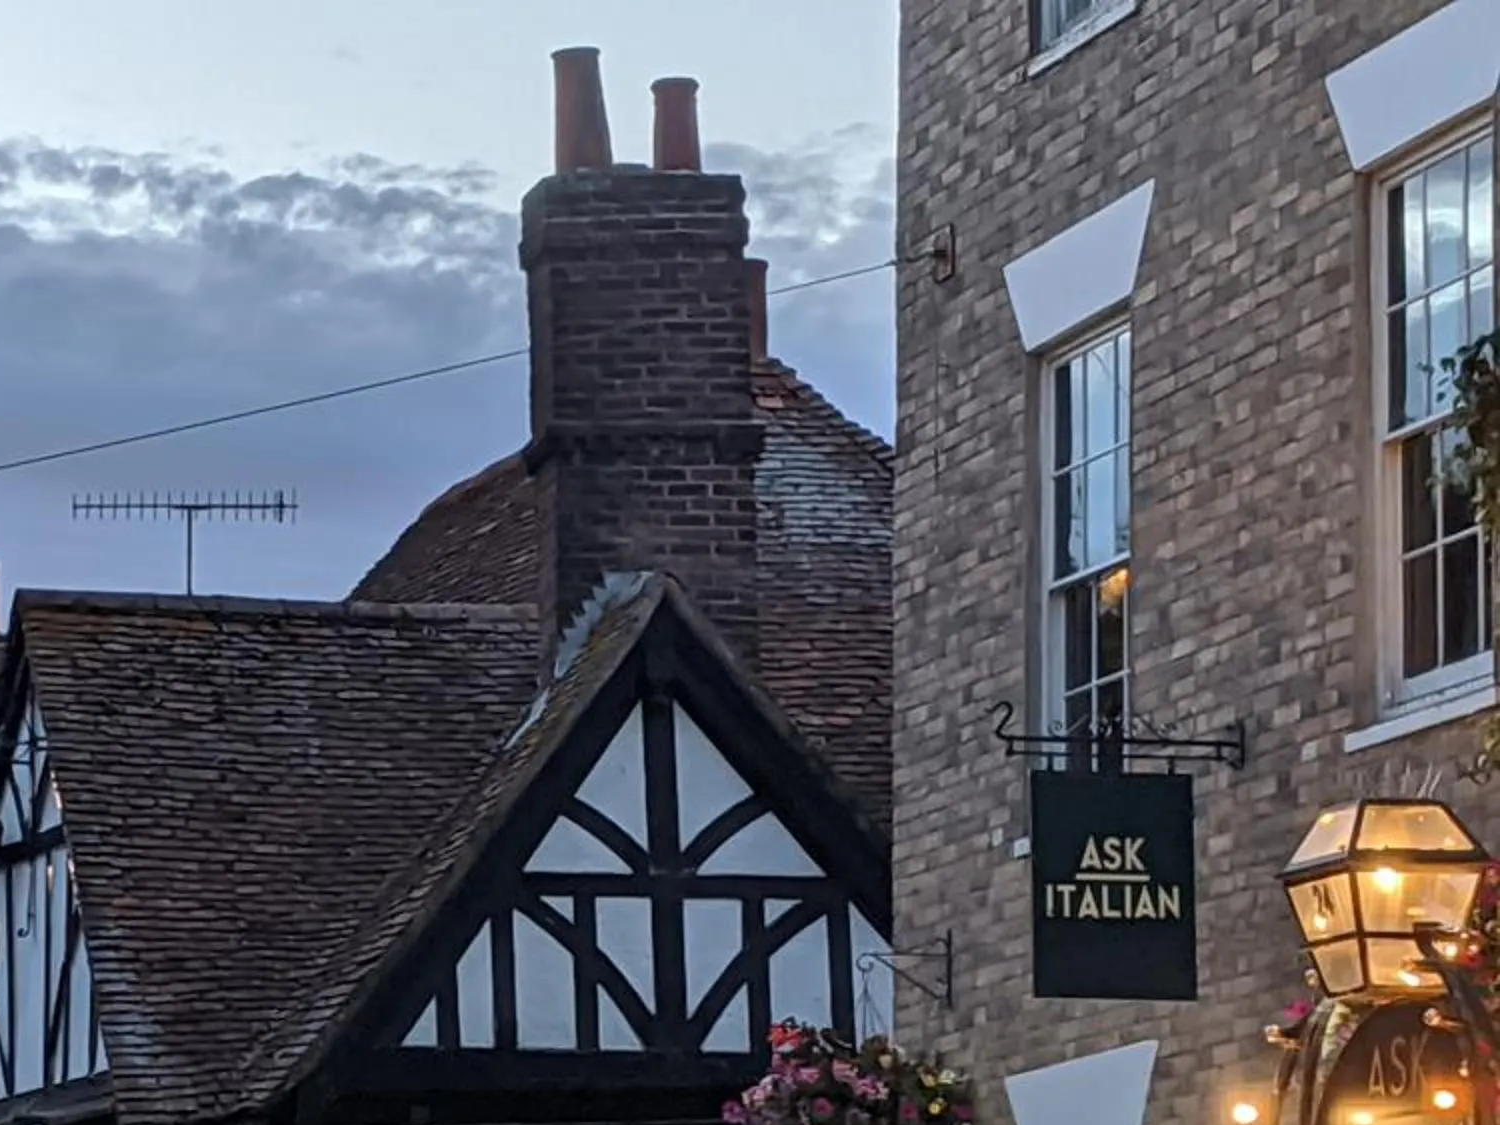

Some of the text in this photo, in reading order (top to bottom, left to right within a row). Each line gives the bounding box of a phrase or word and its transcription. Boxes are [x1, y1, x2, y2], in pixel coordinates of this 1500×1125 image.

[1080, 835, 1145, 871] ASK
[1045, 883, 1181, 920] ITALIAN
[1368, 1034, 1429, 1098] ASK
